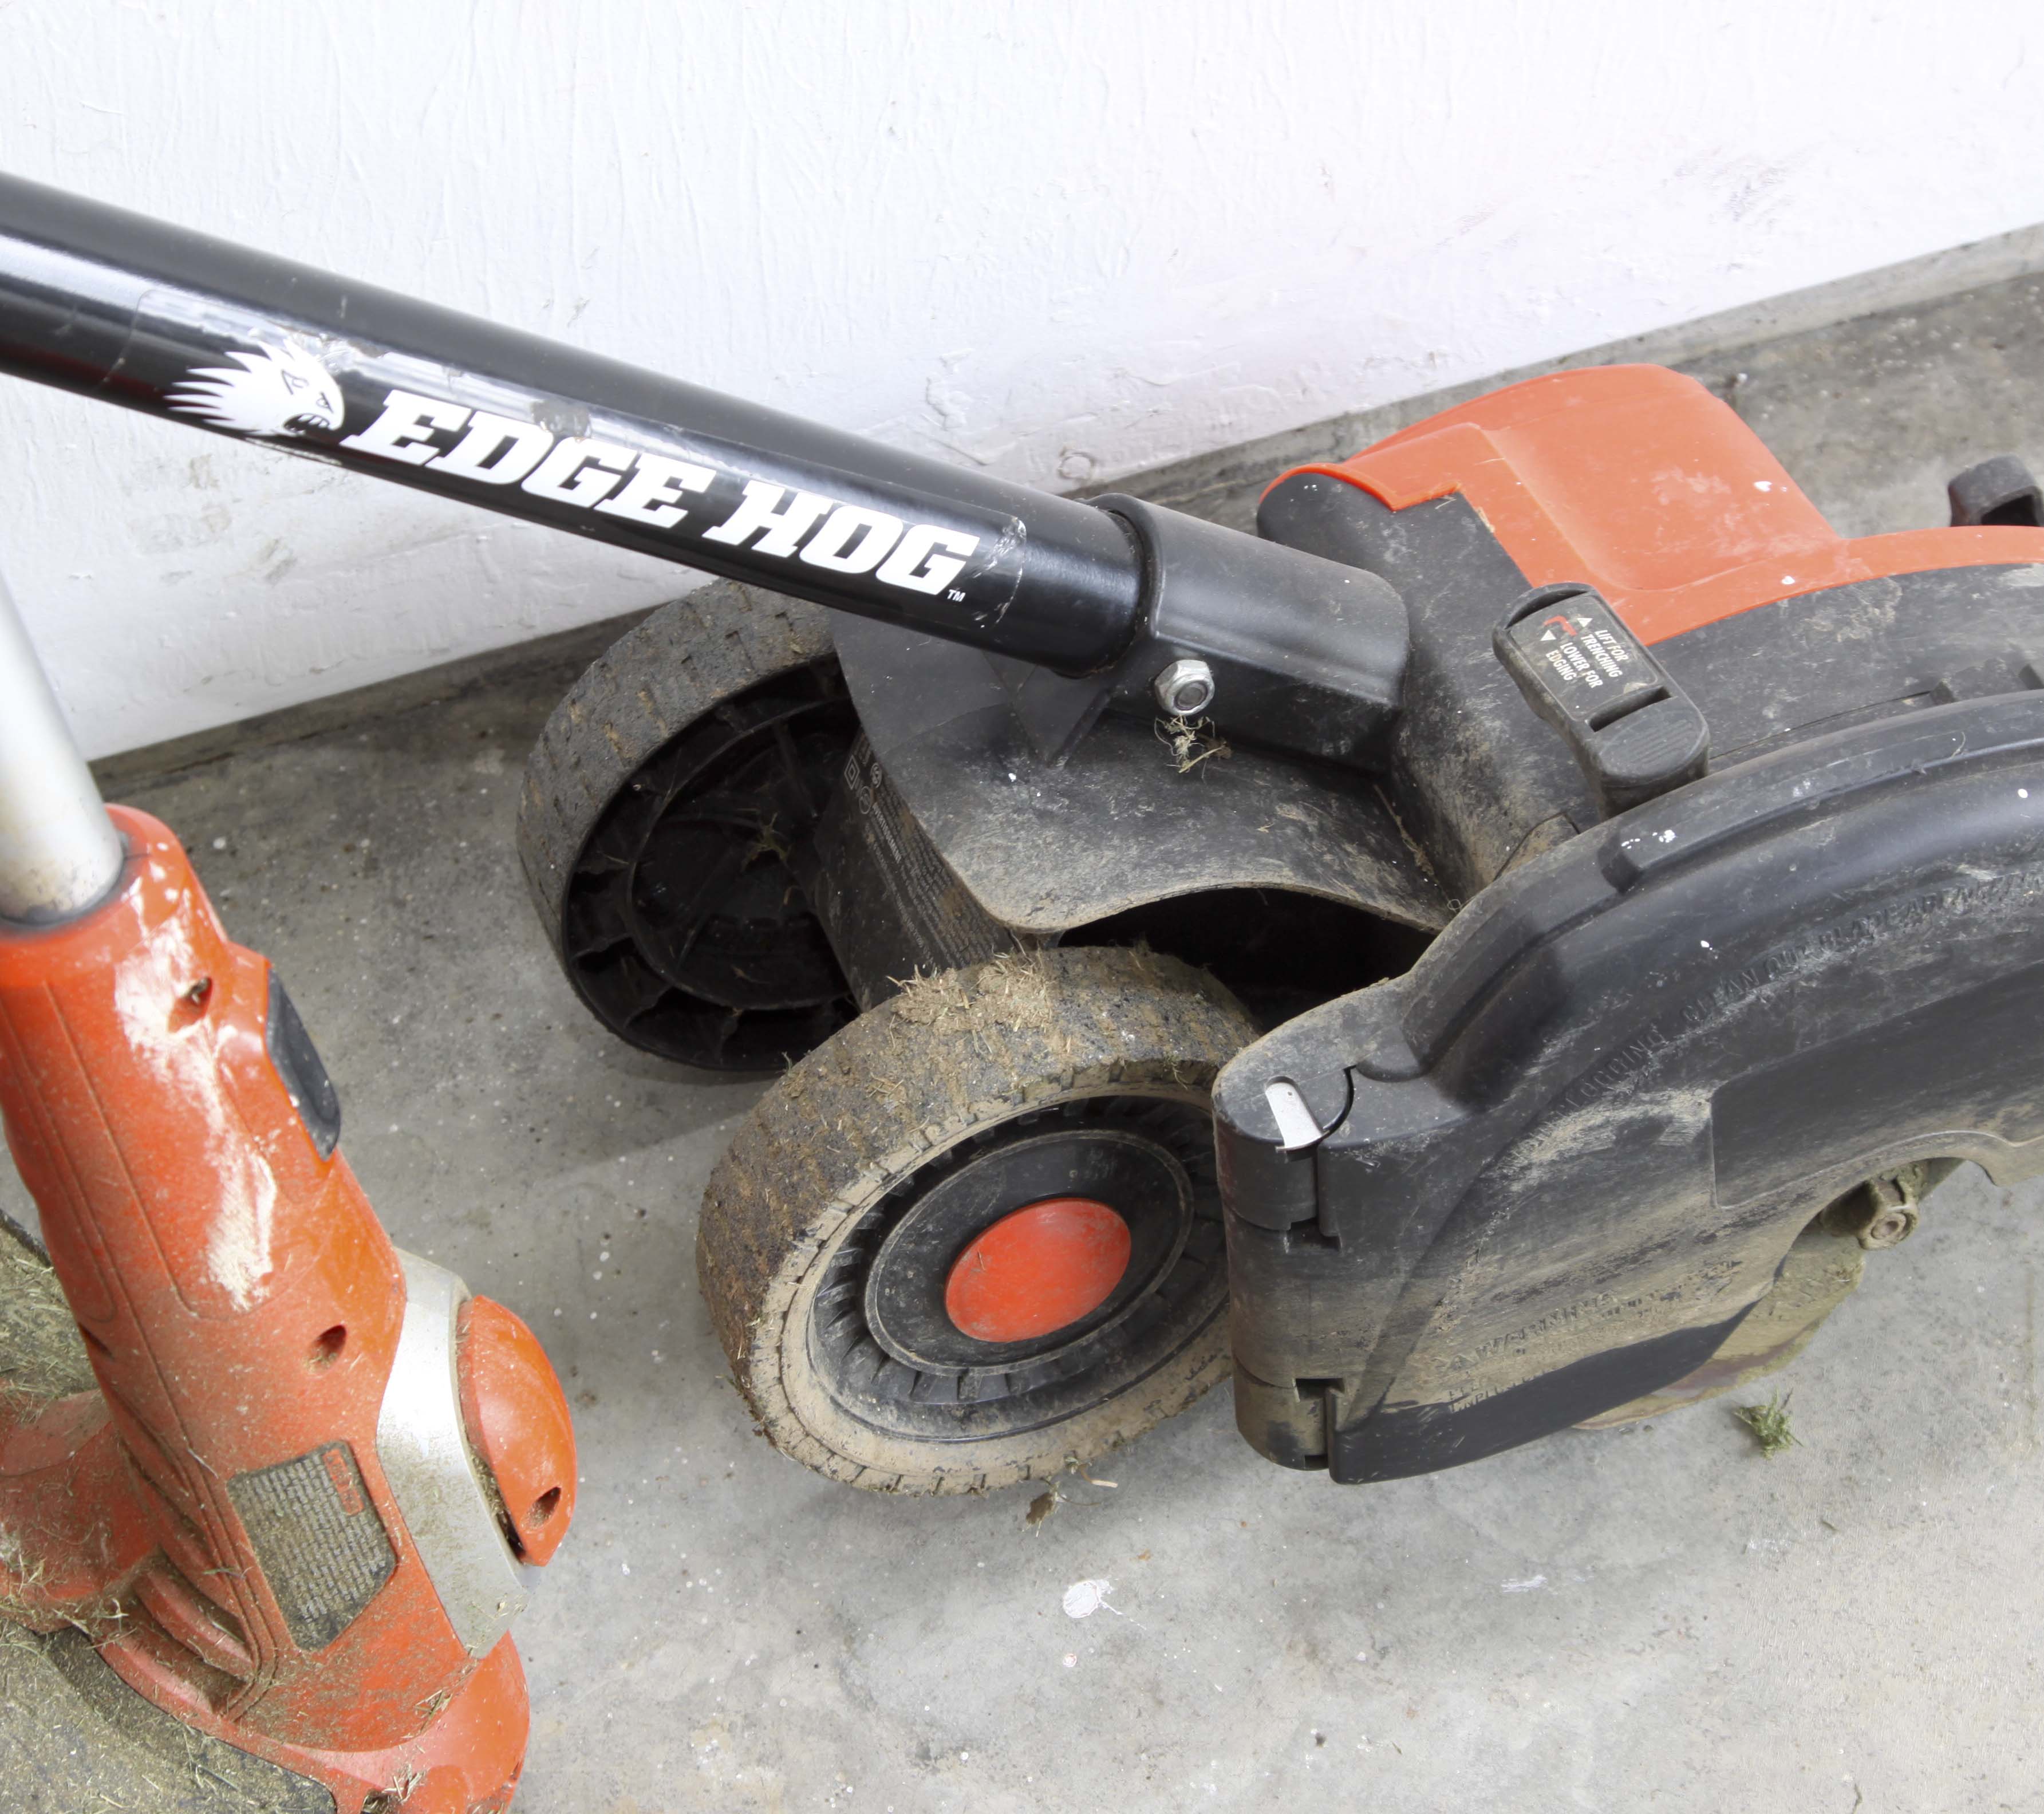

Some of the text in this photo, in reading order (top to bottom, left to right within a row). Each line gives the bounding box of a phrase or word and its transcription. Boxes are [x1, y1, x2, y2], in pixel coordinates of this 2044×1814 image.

[340, 390, 716, 528] EDGE
[703, 481, 980, 596] HOG
[1545, 649, 1577, 680] EDGING
[1560, 642, 1603, 688] LOWER FOR
[1580, 634, 1623, 677] TRENCHING
[1594, 630, 1629, 661] LIFT FOR
